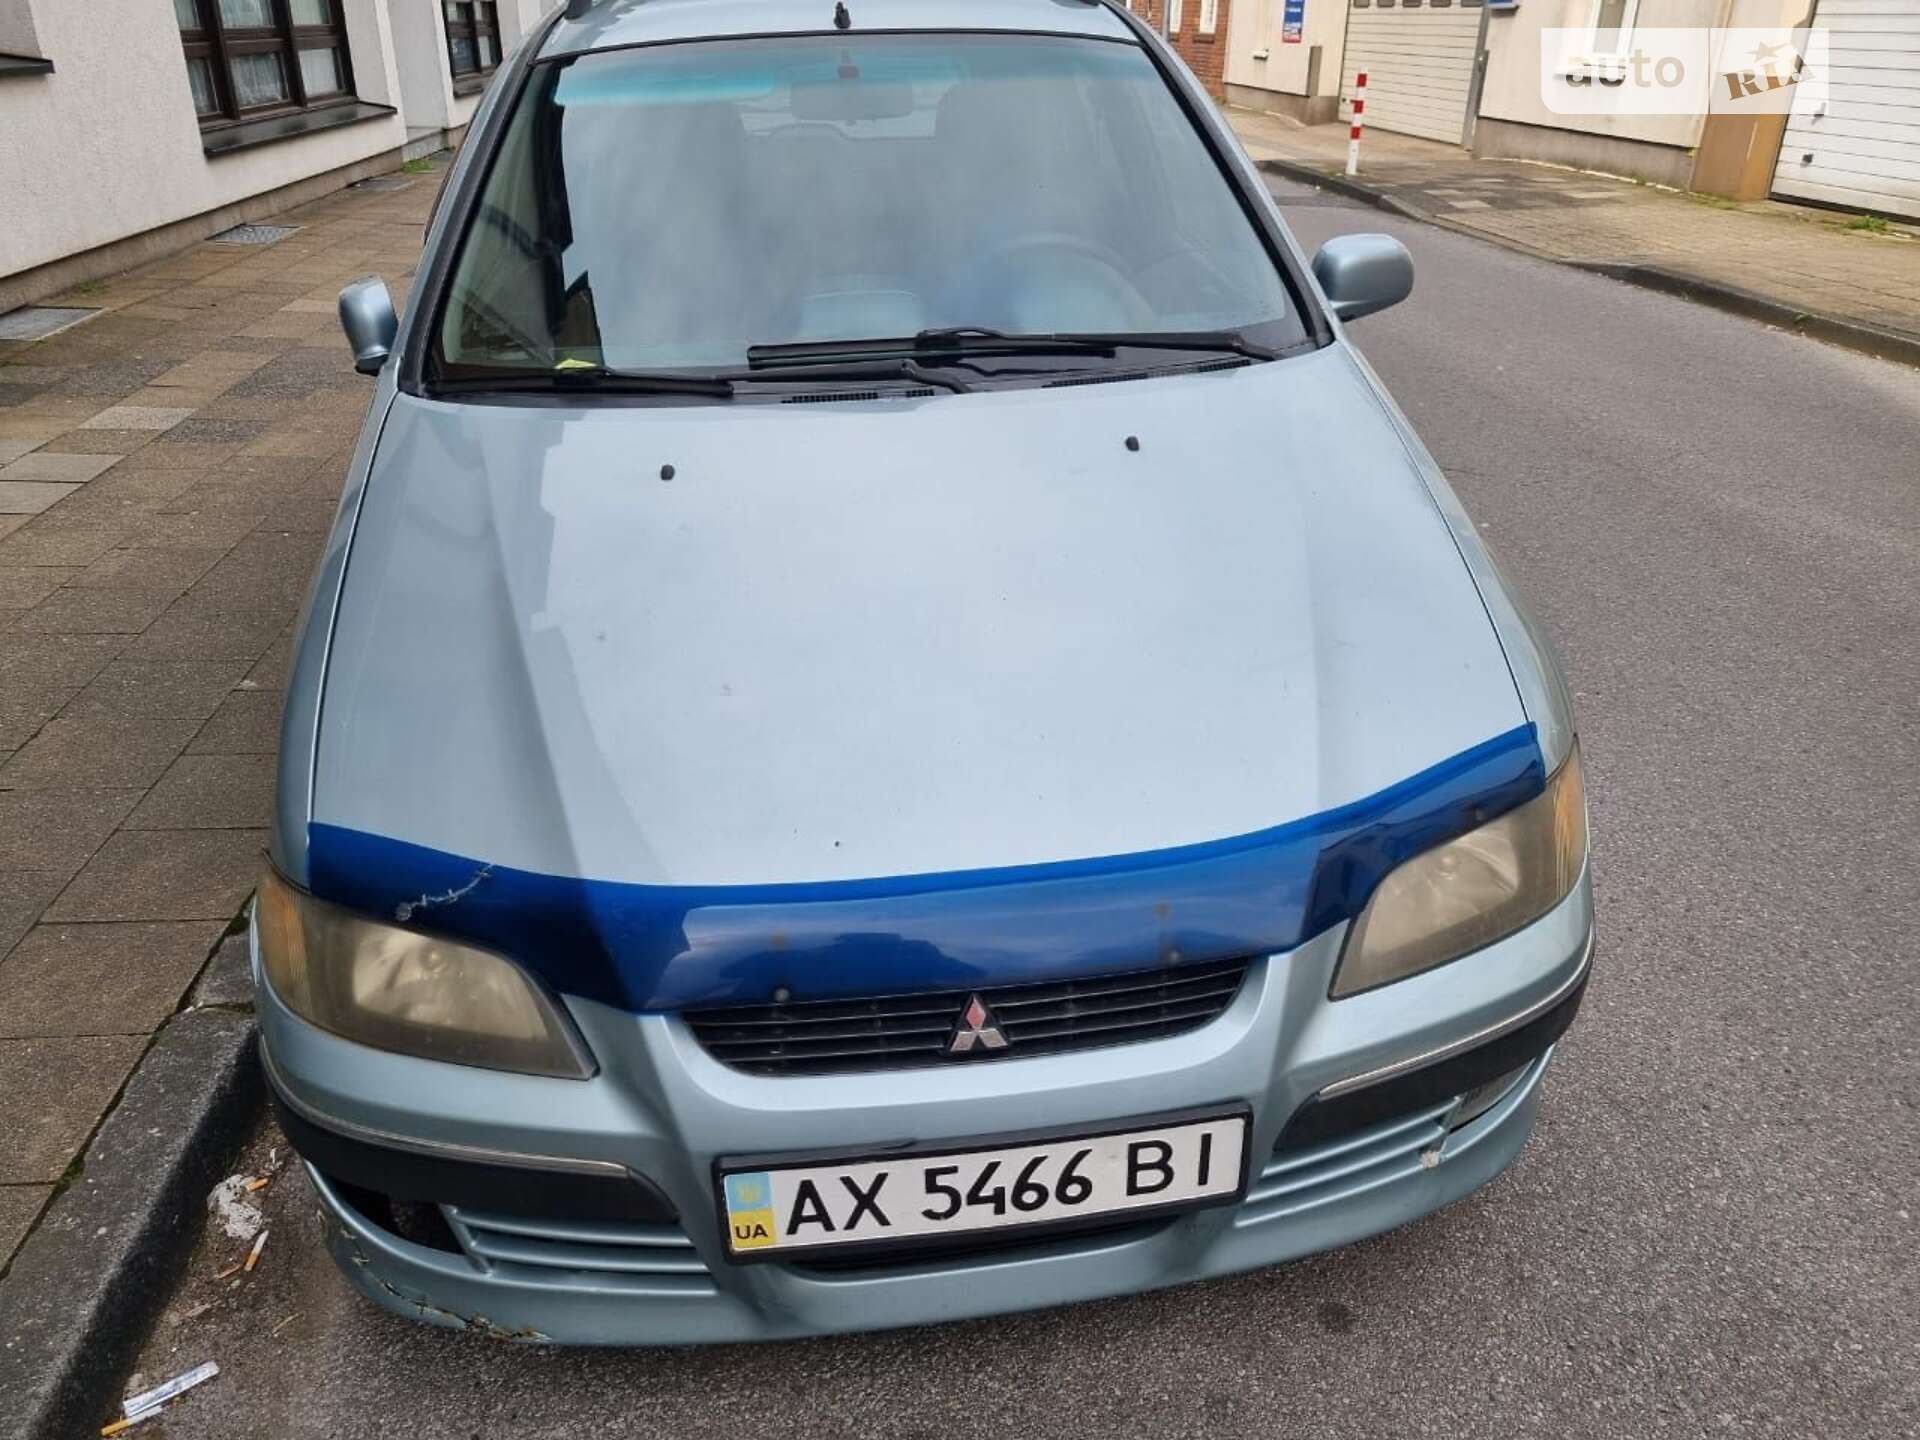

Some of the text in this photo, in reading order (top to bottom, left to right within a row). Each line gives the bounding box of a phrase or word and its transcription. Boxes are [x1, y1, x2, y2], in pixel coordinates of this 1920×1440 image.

[787, 1173, 892, 1236] AX
[922, 1149, 1093, 1221] 5466
[735, 1223, 769, 1241] UA
